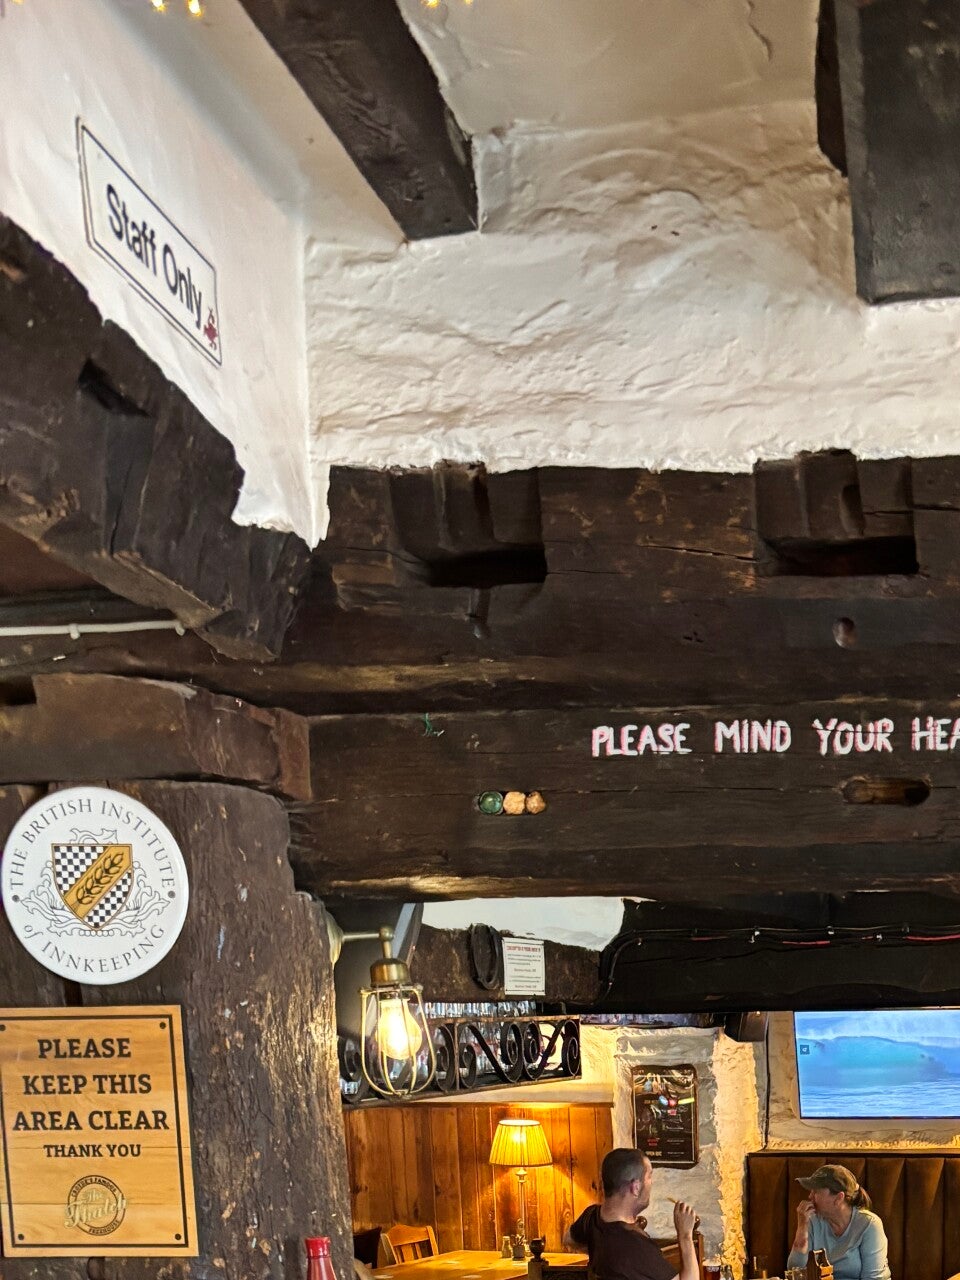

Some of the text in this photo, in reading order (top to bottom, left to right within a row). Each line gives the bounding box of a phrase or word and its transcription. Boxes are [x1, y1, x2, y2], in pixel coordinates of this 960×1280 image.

[106, 183, 203, 330] Staff Only
[591, 722, 693, 757] PLEASE
[714, 719, 792, 754] MIND
[812, 716, 895, 757] YOUR
[10, 798, 176, 891] THE BRITISH INSTITUTE
[24, 924, 165, 973] of INNKEEPING
[37, 1037, 132, 1059] PLEASE
[22, 1073, 152, 1095] KEEP THIS
[12, 1110, 170, 1131] AREA CLEAR
[43, 1143, 142, 1158] THANK YOU
